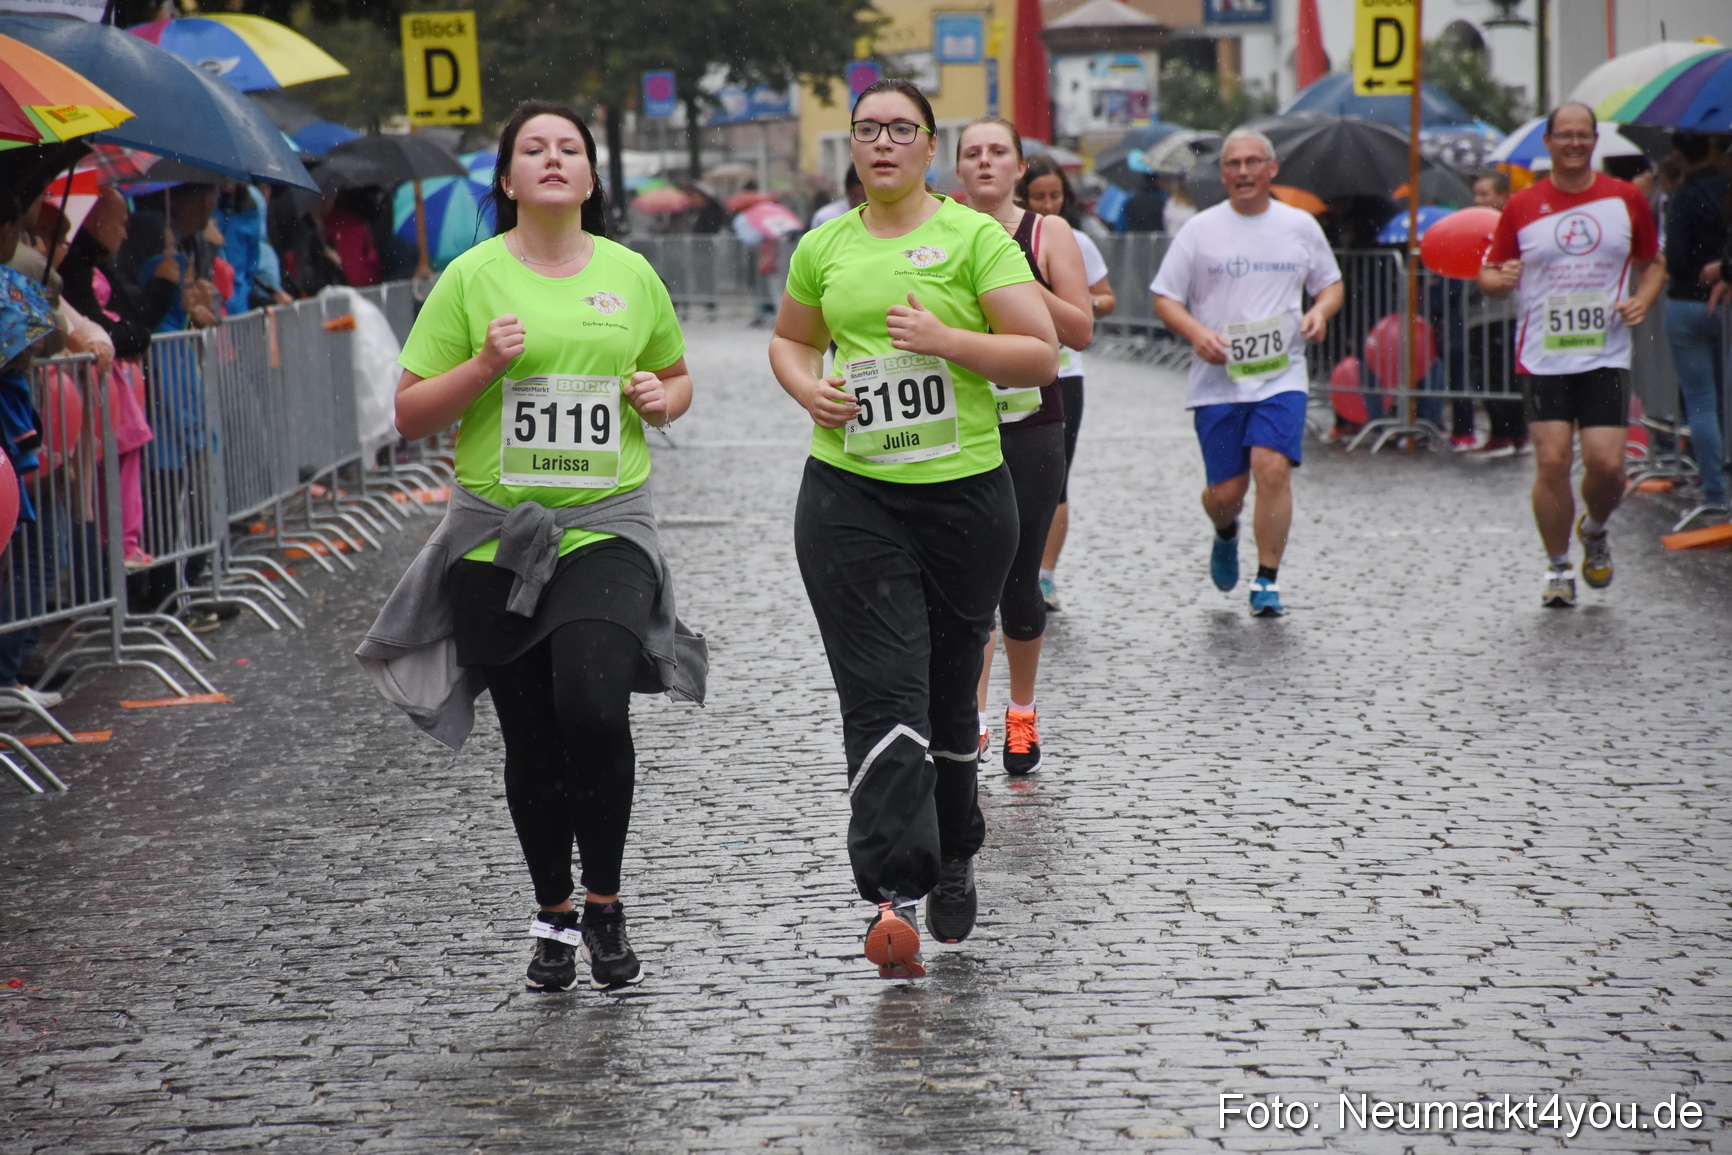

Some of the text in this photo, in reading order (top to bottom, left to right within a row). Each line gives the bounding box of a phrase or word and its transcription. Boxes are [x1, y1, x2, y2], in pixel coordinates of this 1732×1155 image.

[412, 18, 466, 39] Block
[1373, 17, 1404, 69] D
[425, 48, 459, 99] D
[1550, 307, 1605, 332] 5198
[1231, 330, 1283, 361] 5278
[884, 354, 941, 371] BOCK
[557, 379, 610, 393] BOCK
[855, 375, 945, 427] 5190
[514, 401, 610, 445] 5119
[883, 431, 920, 450] Julia
[532, 453, 590, 472] Larissa
